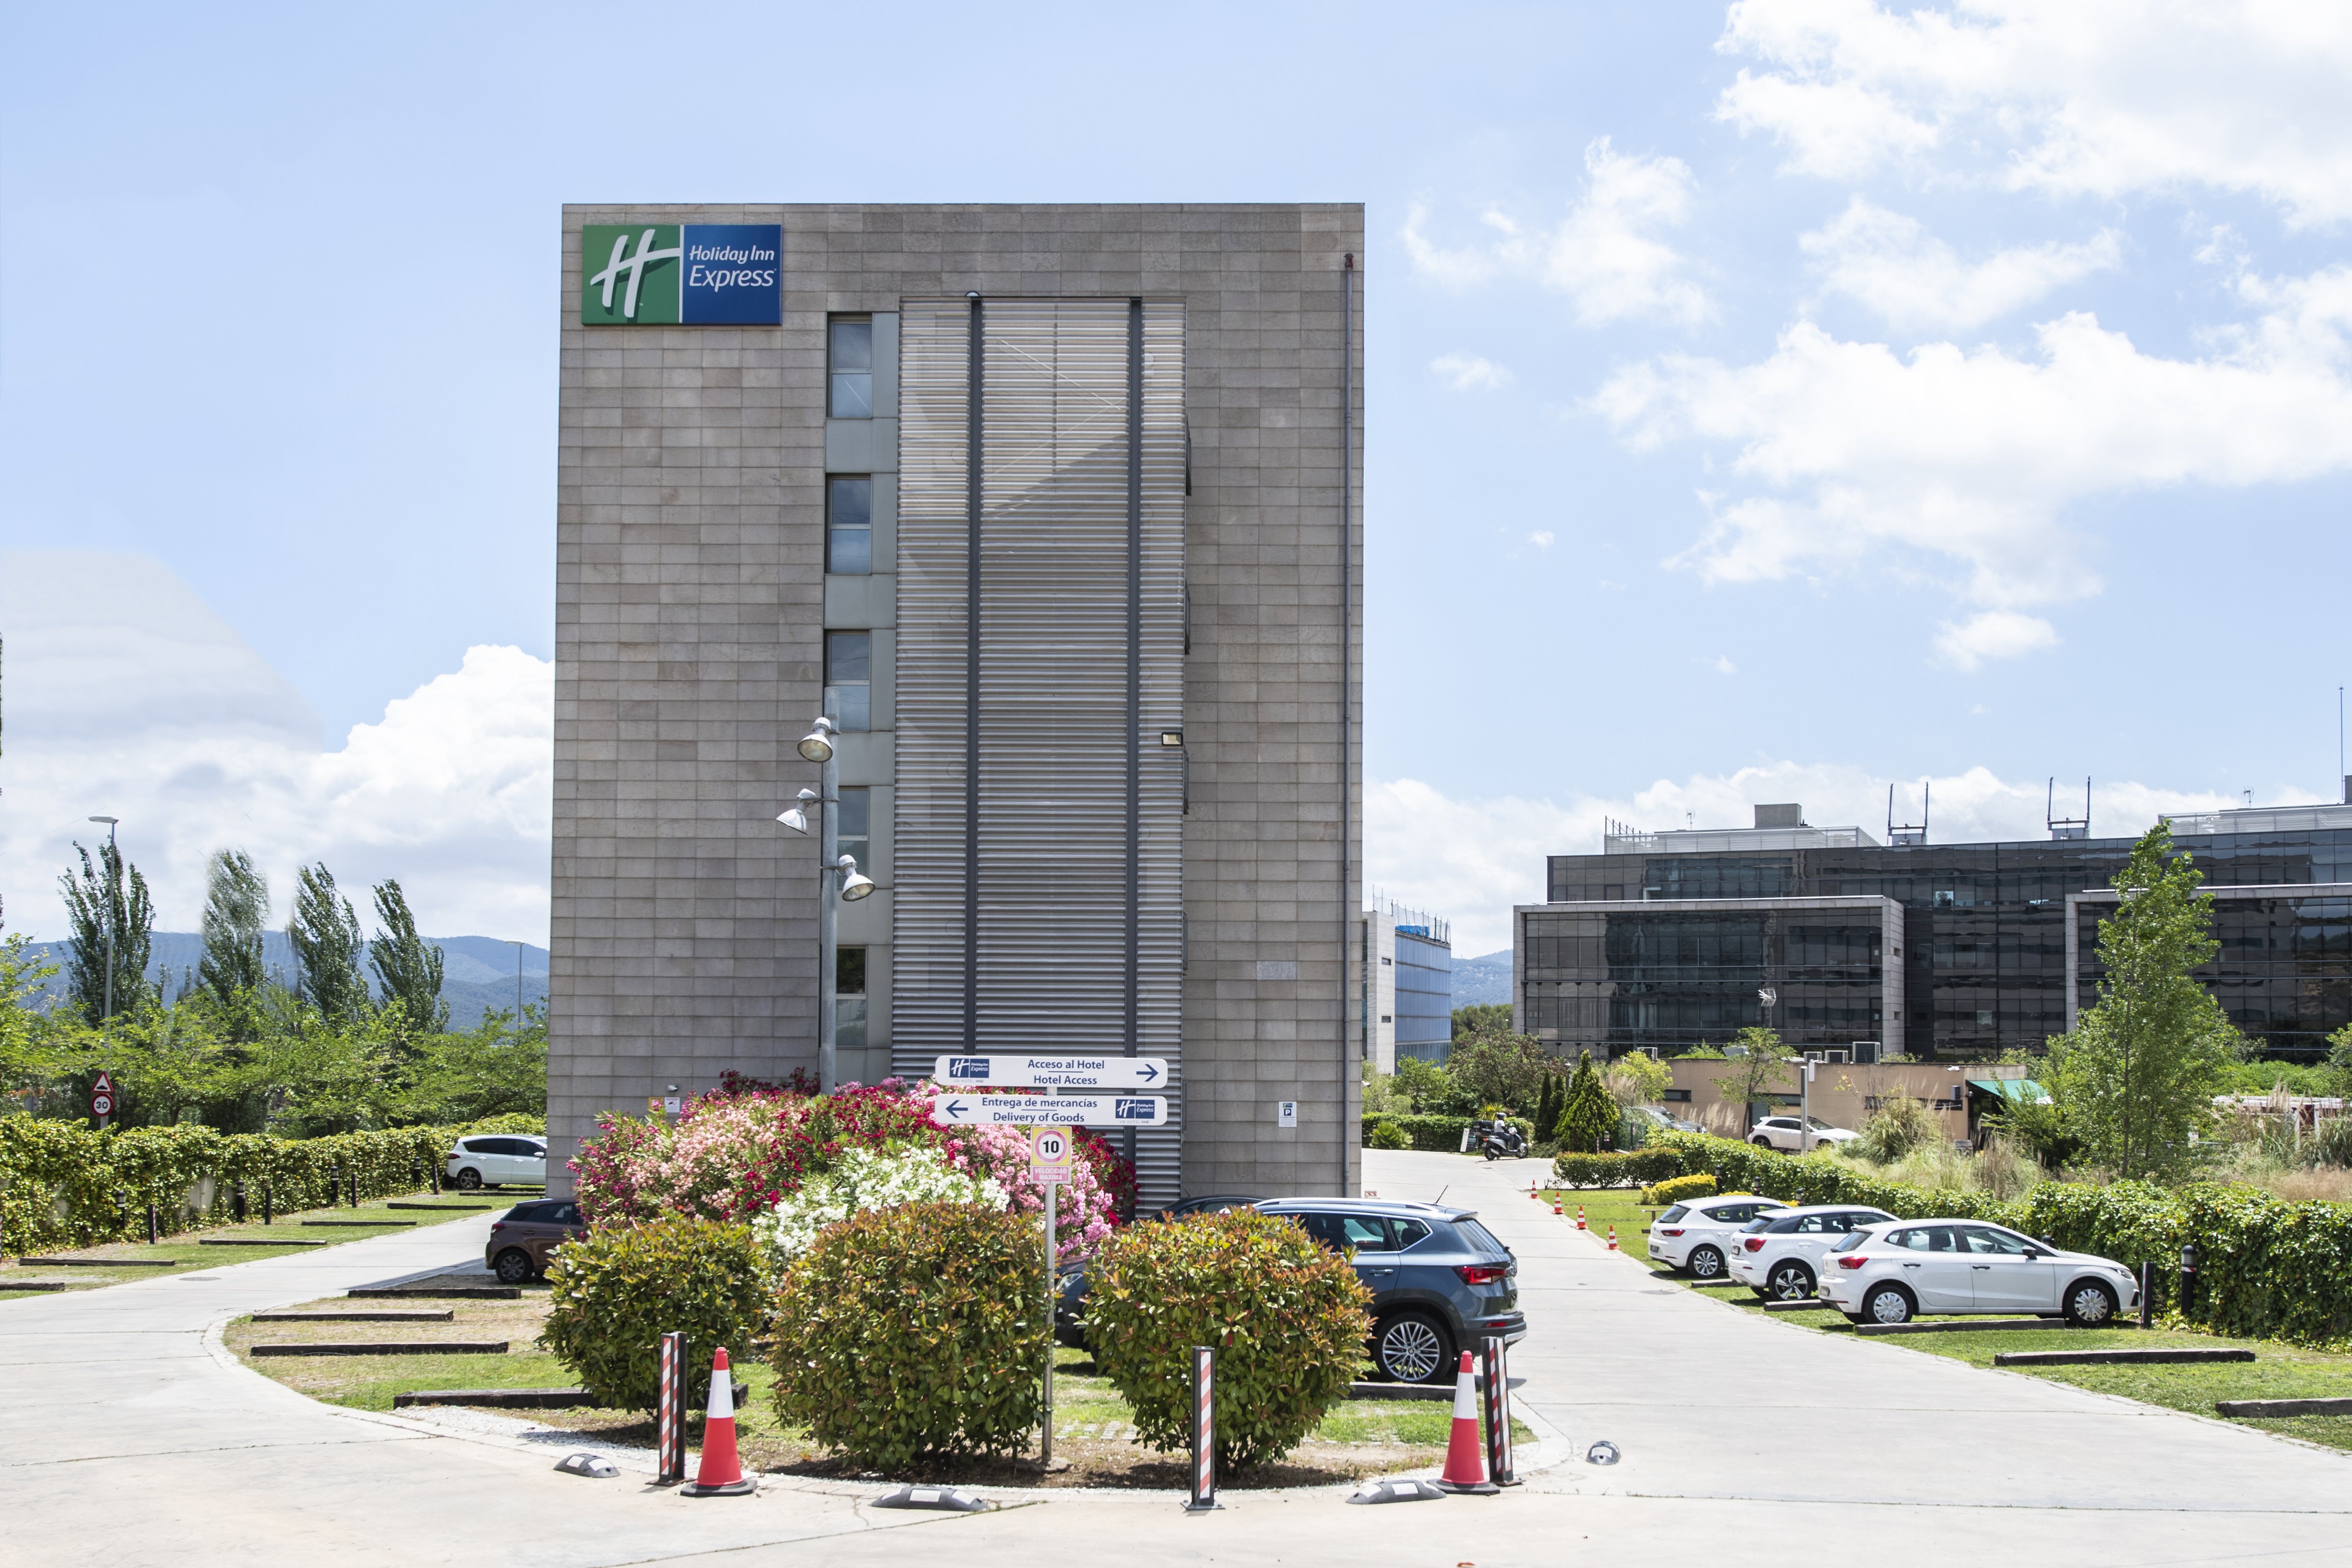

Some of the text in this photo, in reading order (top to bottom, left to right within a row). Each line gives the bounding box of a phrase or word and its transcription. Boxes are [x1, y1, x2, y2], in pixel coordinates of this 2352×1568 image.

[689, 245, 774, 264] Holiday Inn
[689, 265, 774, 292] Express
[1028, 1059, 1105, 1069] Acceso al Hotel
[1034, 1075, 1097, 1084] Hotel Access
[982, 1098, 1097, 1108] Entrega de mercancías
[994, 1112, 1084, 1123] Delivery of Goods
[1043, 1140, 1059, 1153] 10
